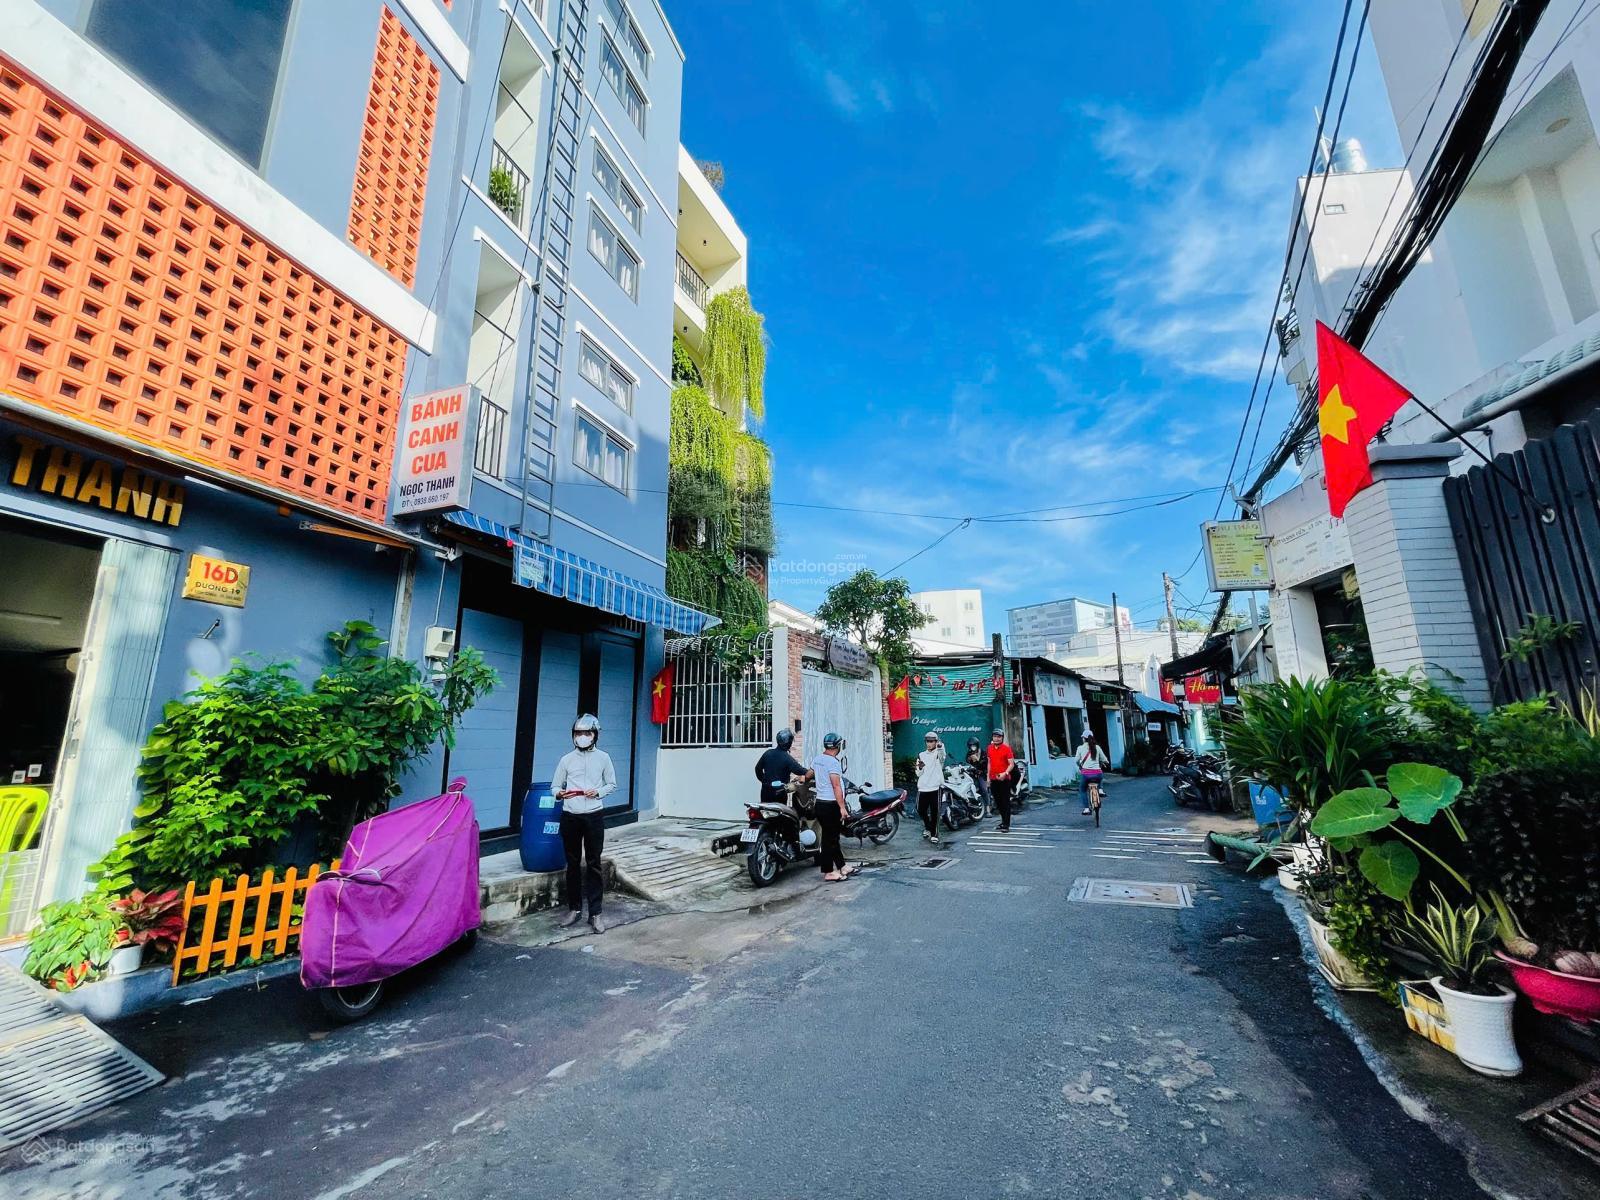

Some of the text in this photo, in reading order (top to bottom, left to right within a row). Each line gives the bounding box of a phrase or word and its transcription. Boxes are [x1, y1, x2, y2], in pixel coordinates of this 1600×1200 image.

[411, 393, 462, 422] BÁNH
[408, 421, 459, 449] CANH
[411, 451, 447, 475] CUA
[12, 435, 186, 527] THANH
[400, 476, 455, 498] NGỌC THANH
[204, 561, 239, 584] 16D
